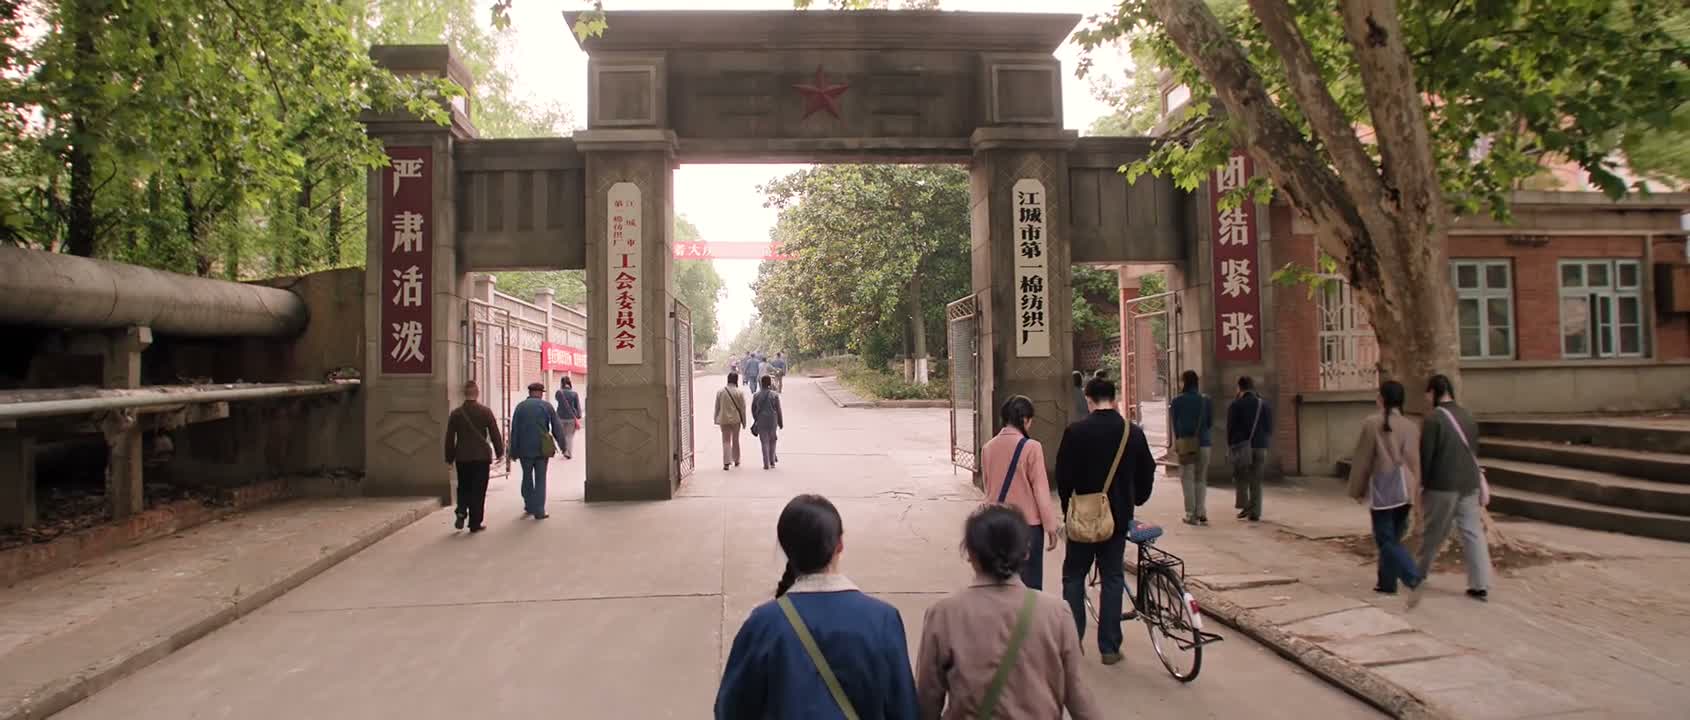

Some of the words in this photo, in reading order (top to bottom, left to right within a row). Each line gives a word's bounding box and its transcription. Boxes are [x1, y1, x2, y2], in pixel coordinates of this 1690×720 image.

[391, 157, 425, 362] 严肃活泼
[613, 253, 637, 350] 工会委员会
[1018, 191, 1044, 345] 江城市第一棉纺织厂
[1216, 155, 1254, 351] 团结紧张
